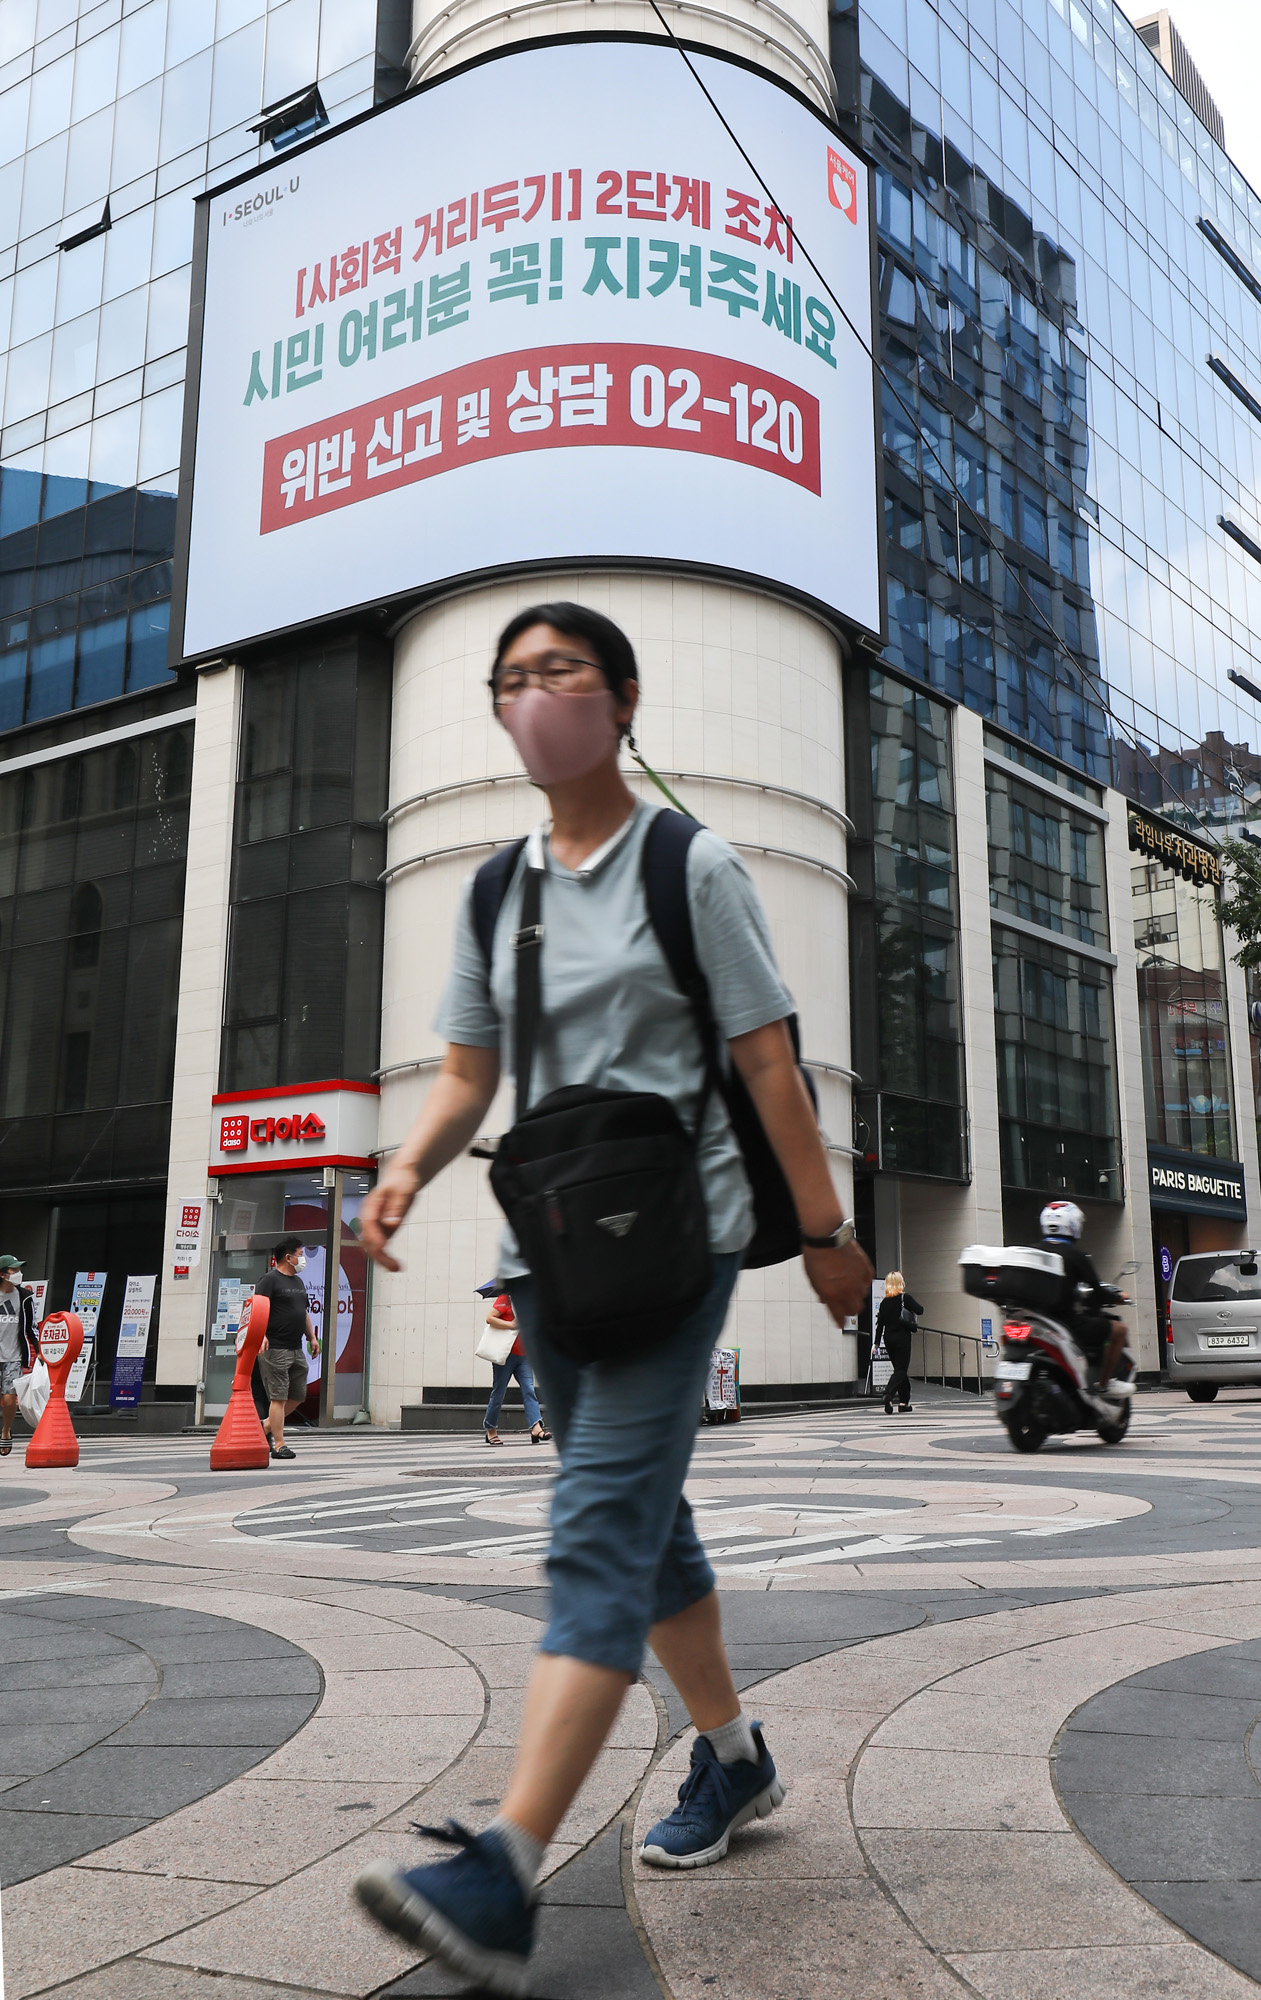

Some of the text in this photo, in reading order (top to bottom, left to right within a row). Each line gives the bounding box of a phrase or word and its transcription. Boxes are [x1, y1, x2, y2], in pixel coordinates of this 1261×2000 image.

[295, 168, 794, 319] [사회적 거리두기] 2단계 조치
[242, 236, 838, 407] 시민 여러분 꼭! 지켜주세요
[280, 363, 804, 510] 위반 신고 및 상담 02-120
[222, 1138, 241, 1147] daiso
[250, 1112, 326, 1143] 다이소
[1152, 1167, 1242, 1200] PARIS BAGUETTE
[176, 1229, 200, 1238] 다이소
[43, 1328, 67, 1341] 주차금지
[1226, 1336, 1245, 1345] 6432
